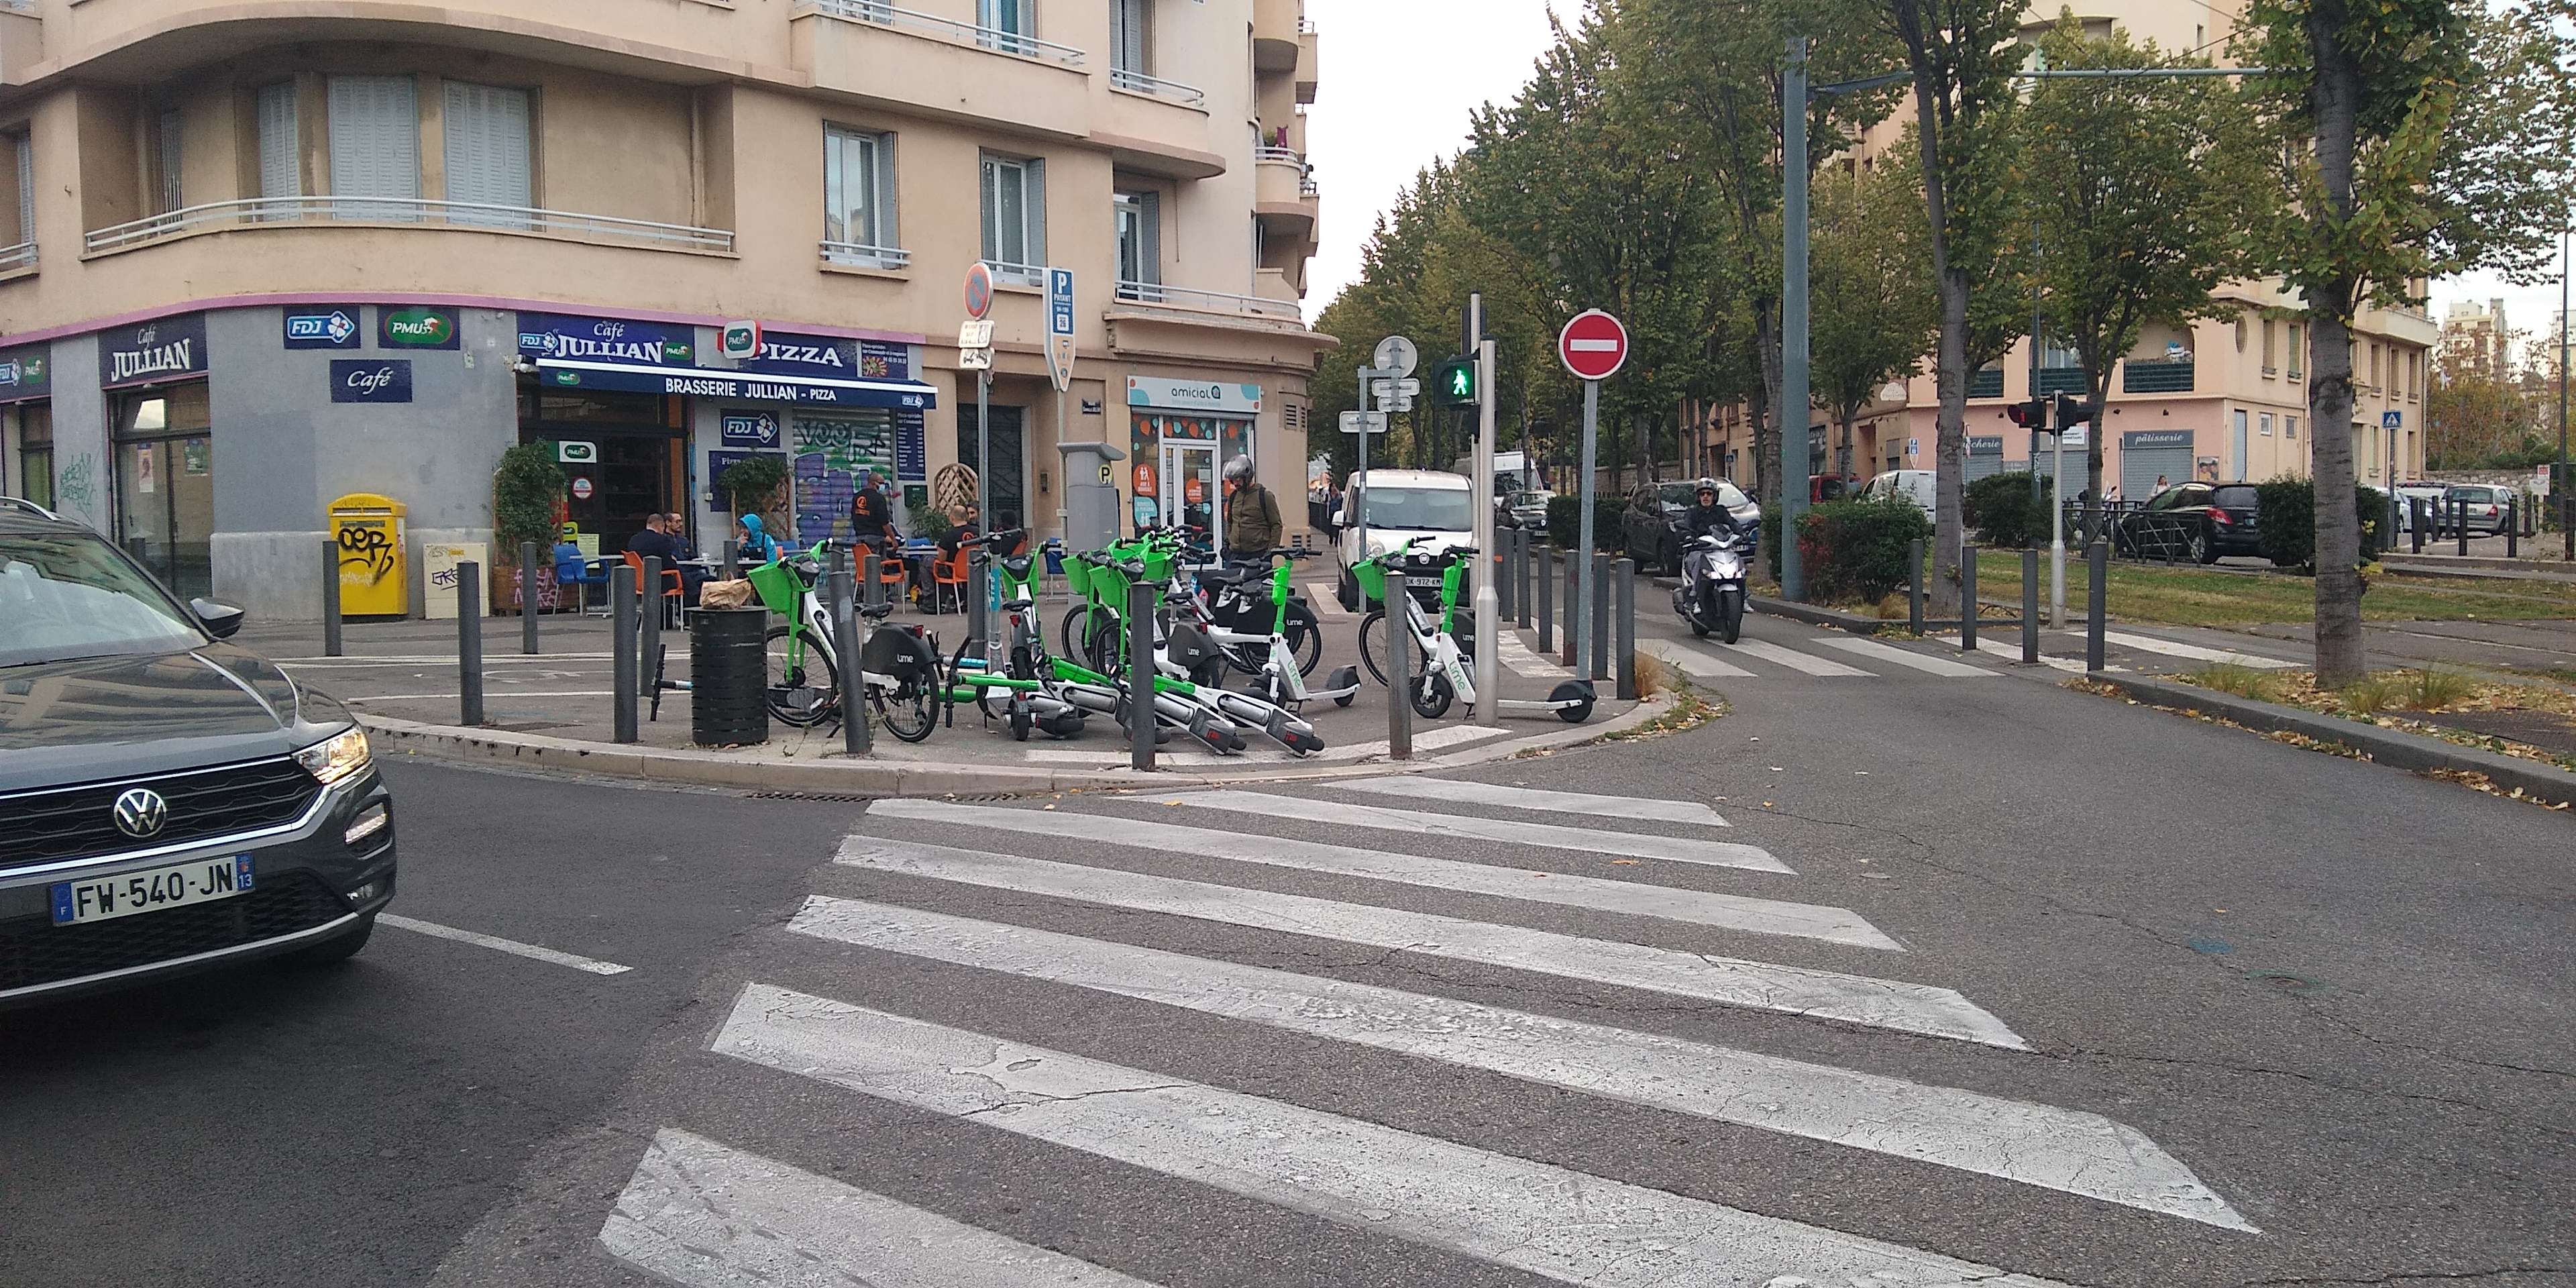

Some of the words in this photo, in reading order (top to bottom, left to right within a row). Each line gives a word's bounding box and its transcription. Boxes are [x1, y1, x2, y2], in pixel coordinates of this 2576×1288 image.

[1057, 272, 1067, 294] P
[1054, 294, 1071, 302] PAYANT
[291, 320, 322, 334] FDJ
[392, 322, 422, 334] PMU
[593, 322, 626, 342] Café
[138, 323, 156, 350] Café
[521, 336, 540, 345] FDJ
[728, 336, 741, 345] PMU
[555, 334, 663, 364] JULLIAN
[665, 347, 682, 356] PMU
[111, 338, 191, 382] JULLIAN
[347, 367, 393, 394] Café
[665, 378, 737, 396] BRASSERIE
[745, 383, 797, 400] JULLIAN
[810, 388, 837, 401] PIZZA
[1171, 387, 1211, 398] amicial
[903, 396, 914, 404] FDJ
[727, 421, 752, 434] FDJ
[2135, 433, 2184, 445] pâtisserie
[1102, 467, 1110, 482] P
[897, 653, 914, 663] Lime
[1287, 660, 1301, 688] Lime
[1448, 660, 1466, 691] Lime
[60, 906, 66, 916] F
[76, 863, 233, 918] FW-540-JN
[239, 874, 253, 888] 13
